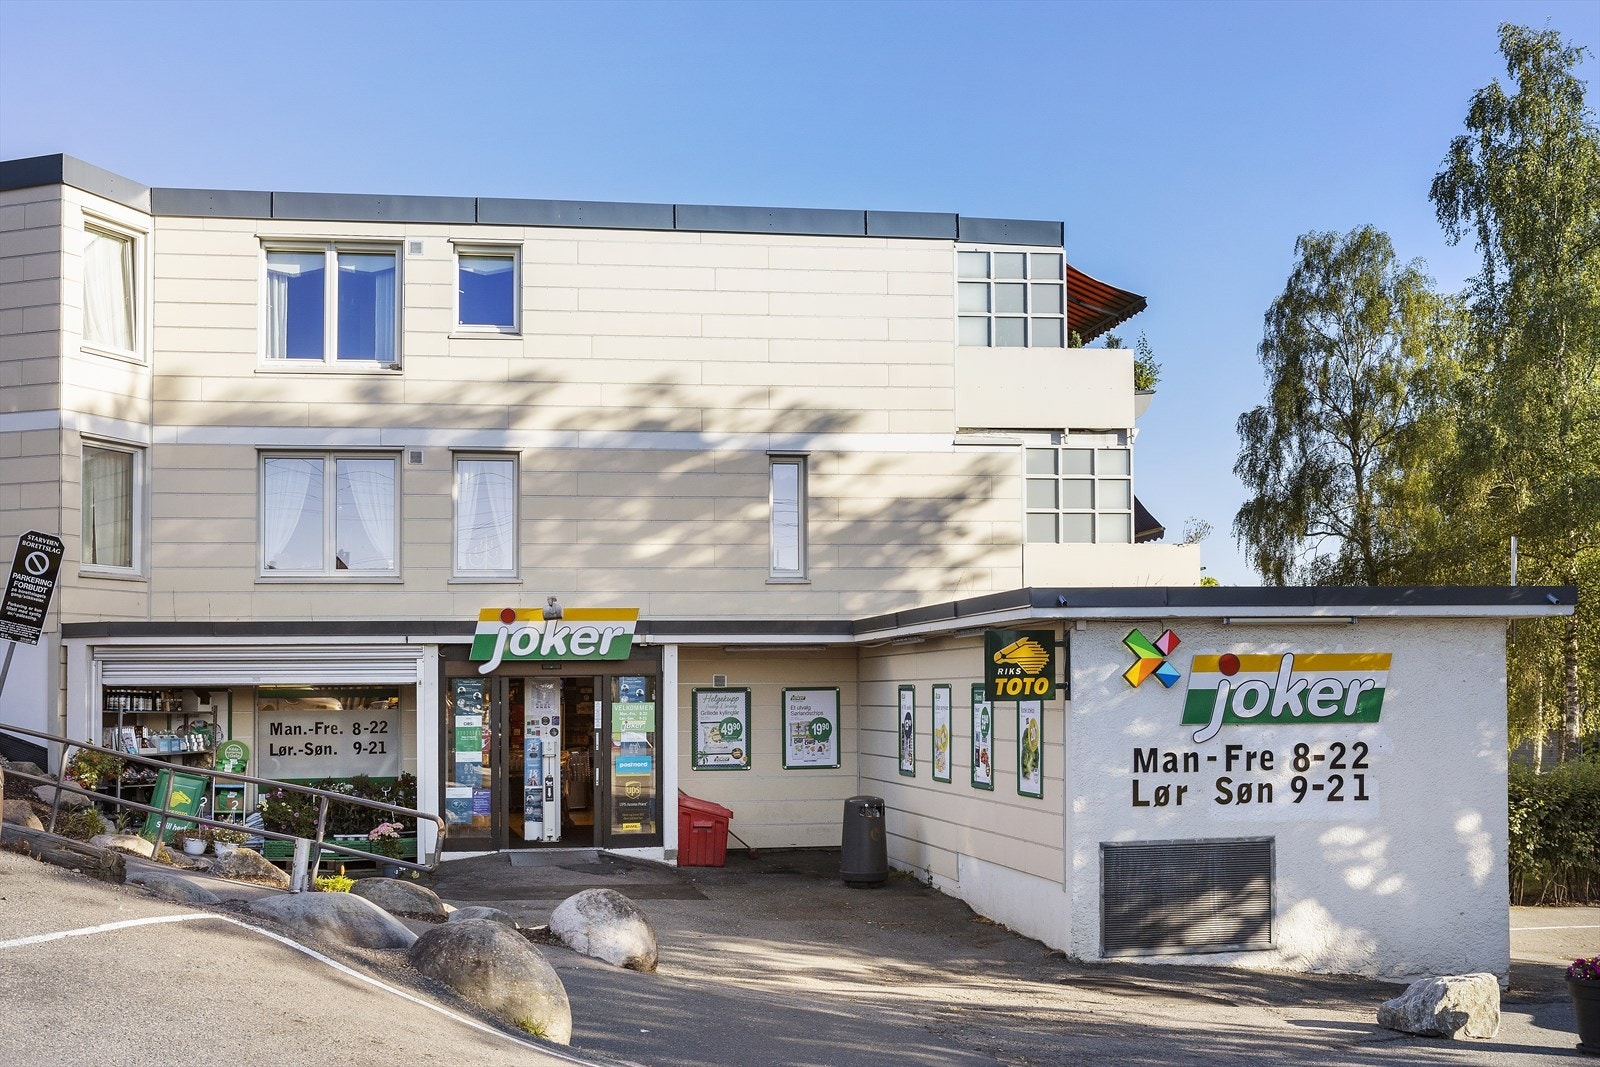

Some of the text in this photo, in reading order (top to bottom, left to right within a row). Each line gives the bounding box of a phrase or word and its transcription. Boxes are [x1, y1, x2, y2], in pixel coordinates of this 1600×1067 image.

[22, 540, 61, 554] BORETTSLAG
[27, 534, 60, 547] STARVEIEN
[12, 572, 53, 588] PARKERING
[13, 580, 48, 594] FORBUDT
[478, 608, 625, 675] joker
[997, 667, 1022, 675] RIKS
[995, 677, 1049, 696] TOTO
[1192, 652, 1376, 743] joker
[269, 720, 388, 736] Man.-Fre. 8-22
[621, 720, 644, 732] joker
[269, 741, 387, 757] Lør.-Søn. 9-21
[1293, 741, 1369, 773] 8-22
[619, 761, 648, 769] postnord
[626, 786, 640, 796] ups
[1131, 773, 1369, 808] Lør Søn 9-21
[156, 820, 173, 831] Sill
